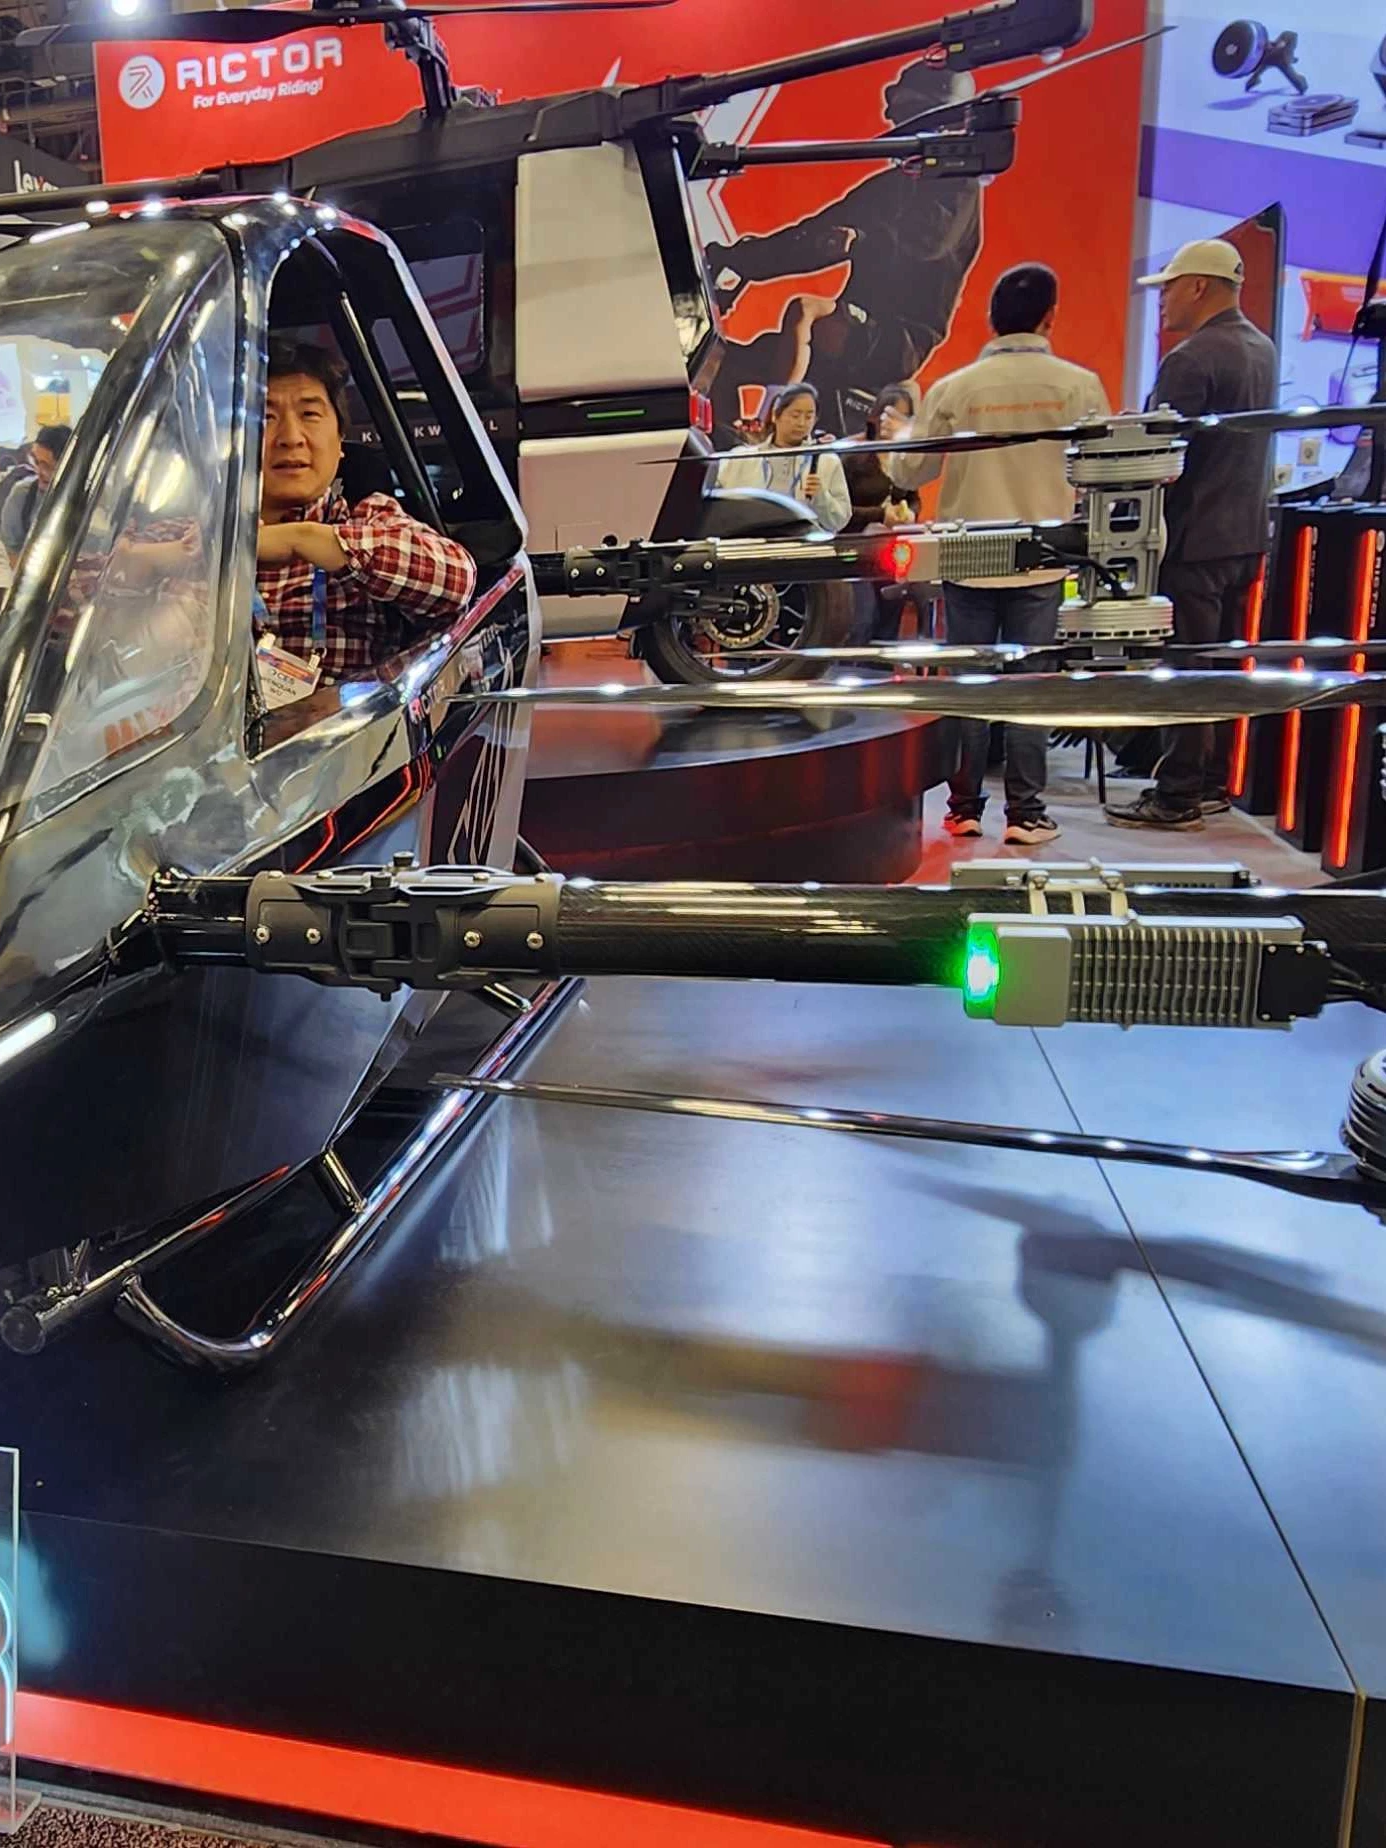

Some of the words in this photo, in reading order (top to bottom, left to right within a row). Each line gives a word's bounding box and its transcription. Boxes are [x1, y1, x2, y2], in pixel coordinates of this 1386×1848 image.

[176, 37, 343, 90] RICTOR
[193, 94, 215, 109] For
[216, 86, 276, 107] Everyday
[277, 77, 324, 97] Riding!
